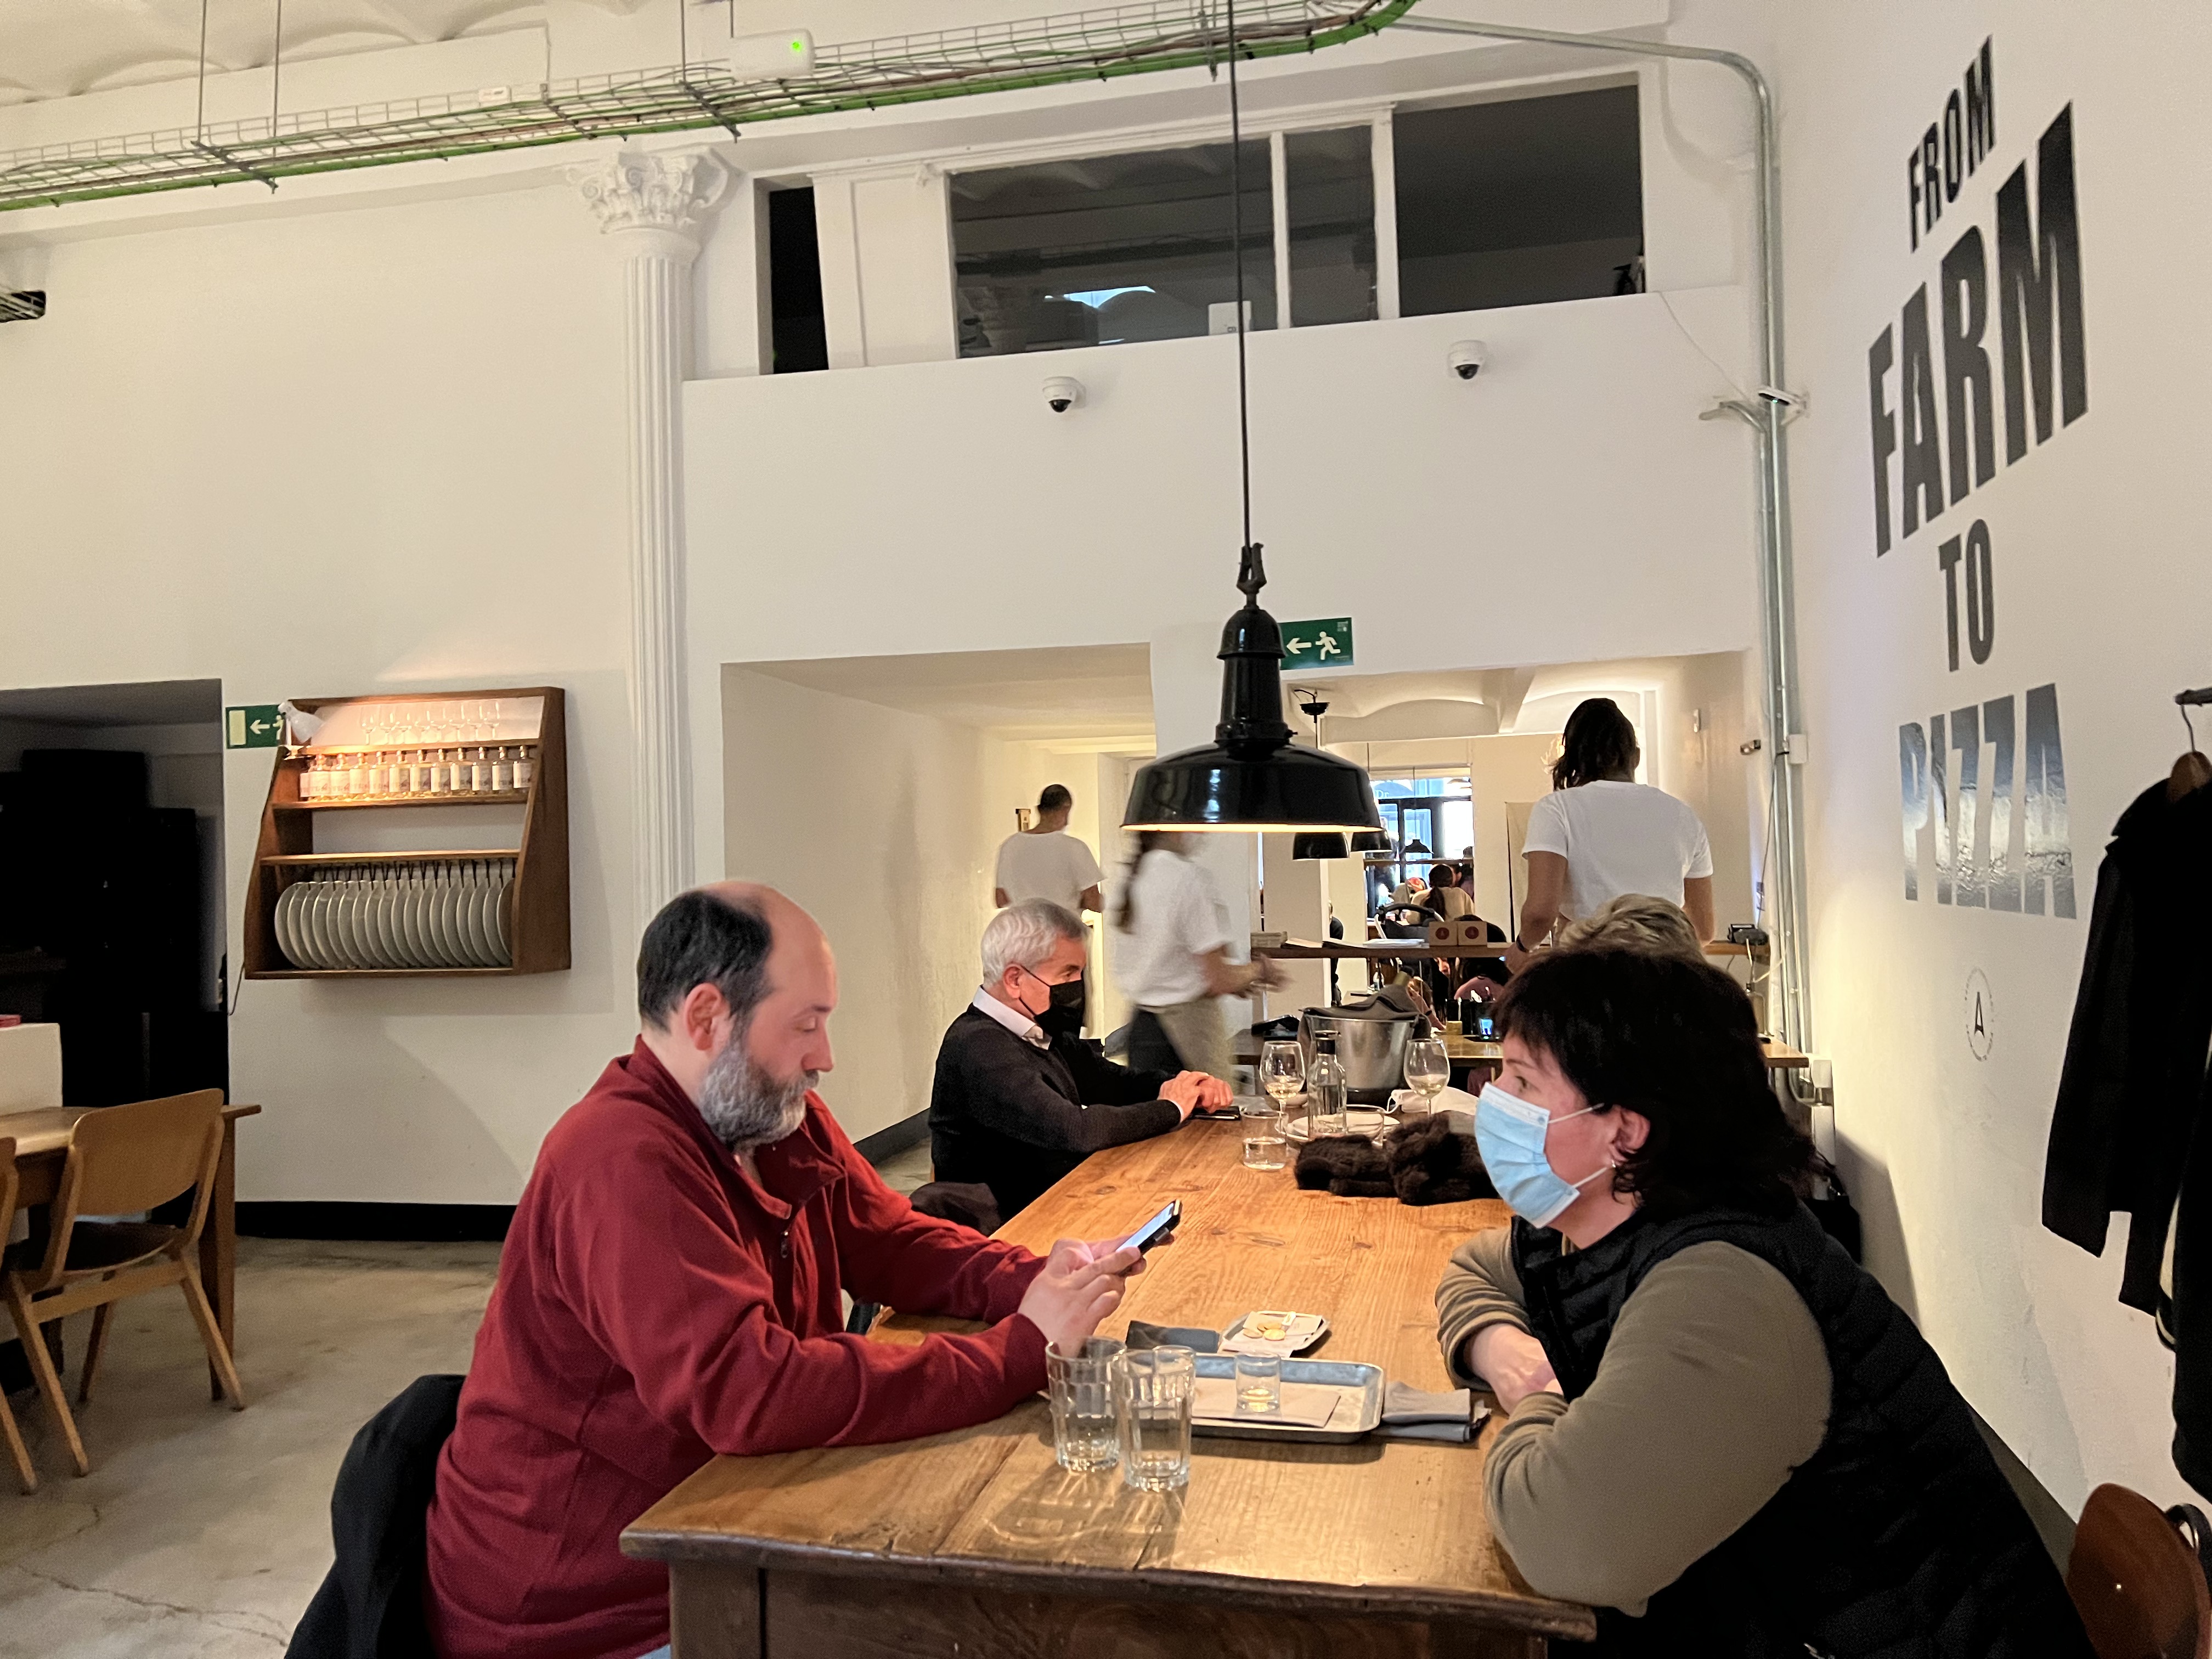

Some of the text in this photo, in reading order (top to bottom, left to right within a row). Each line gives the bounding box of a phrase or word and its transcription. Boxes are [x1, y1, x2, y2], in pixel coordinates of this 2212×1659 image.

[1908, 35, 1995, 253] FROM
[1869, 99, 2088, 557] FARM
[1938, 518, 1995, 672] TO
[1899, 682, 2077, 920] PIZZA
